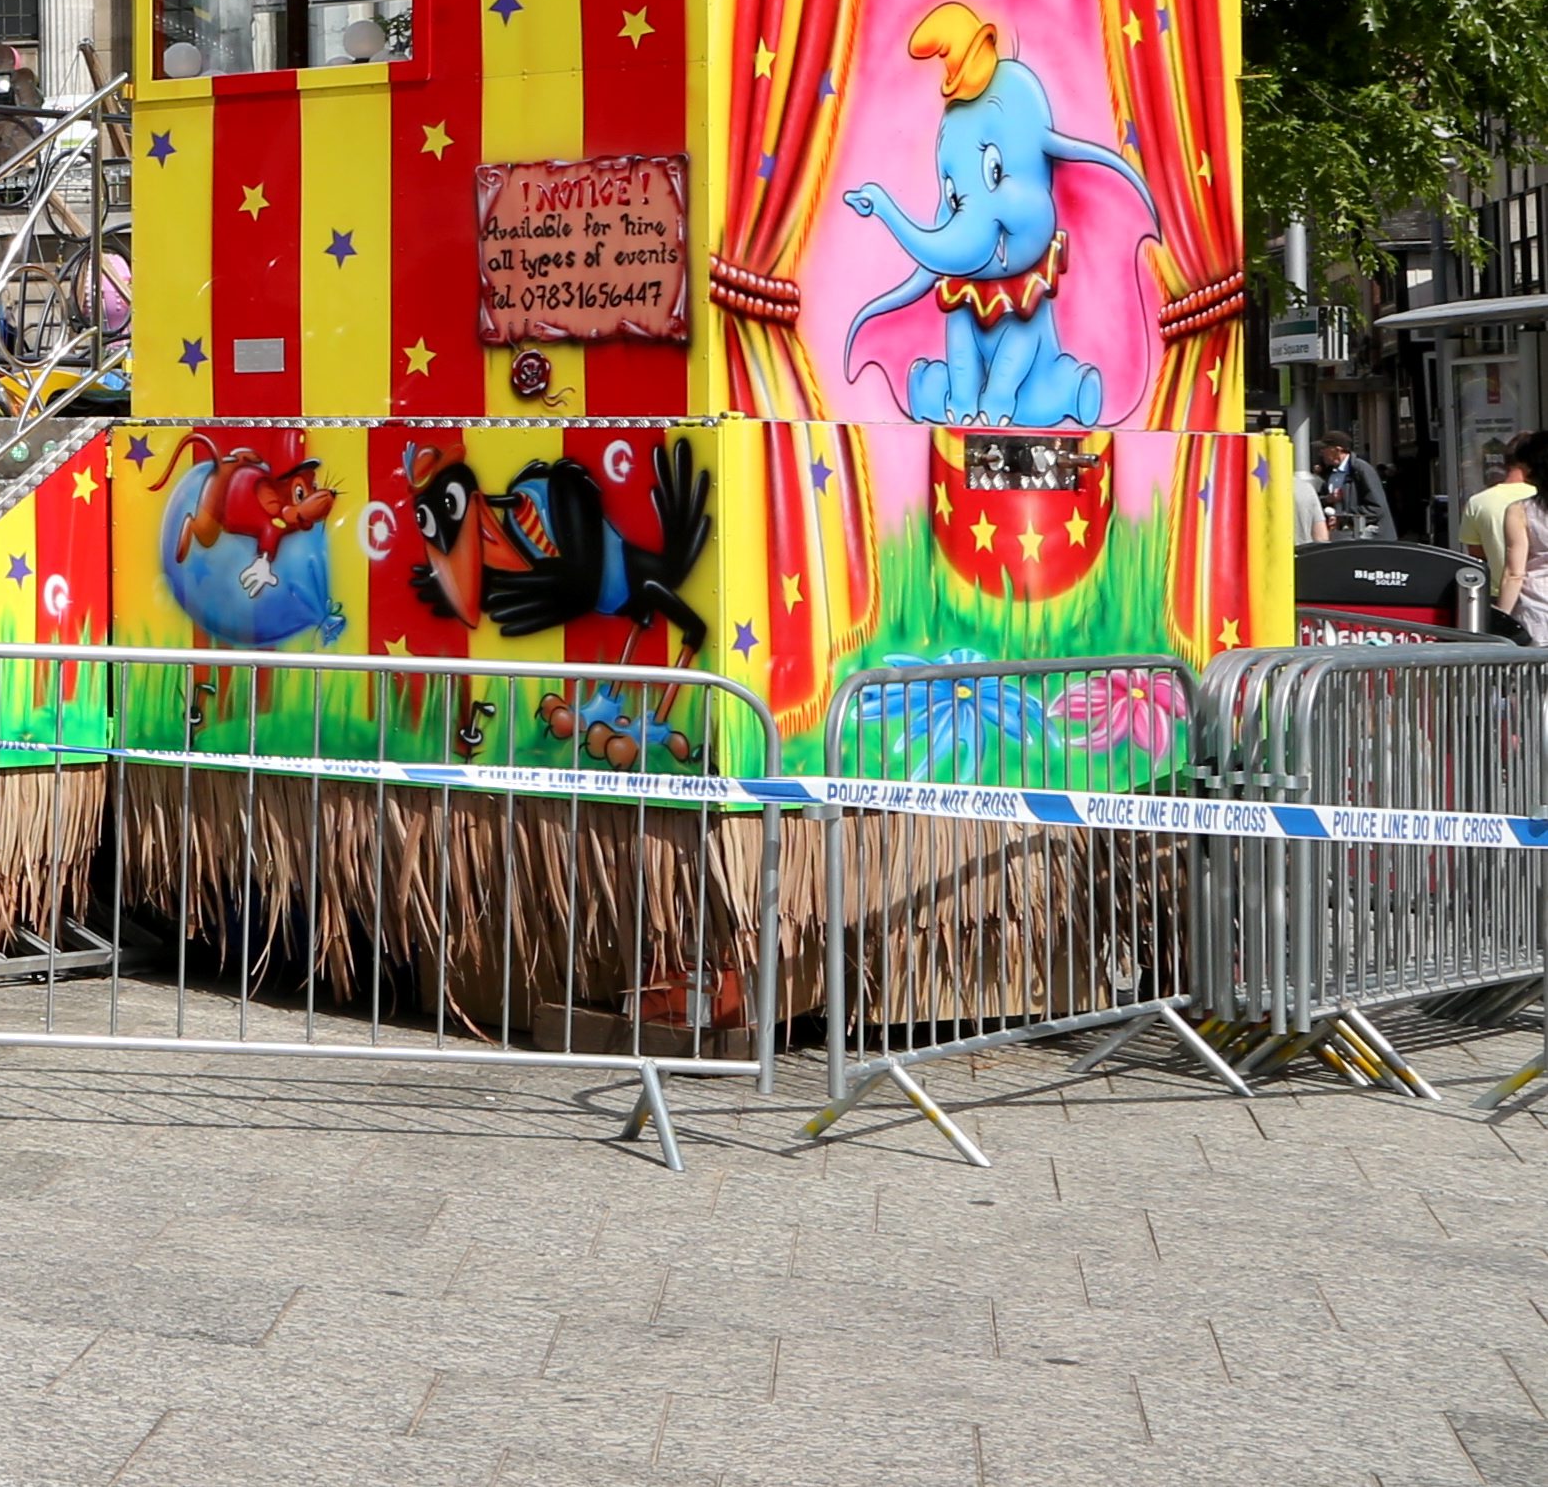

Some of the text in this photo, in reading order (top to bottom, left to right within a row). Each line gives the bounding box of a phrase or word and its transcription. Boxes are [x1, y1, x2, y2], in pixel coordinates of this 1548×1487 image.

[484, 212, 666, 241] Available for hire
[488, 242, 678, 279] all types of events
[520, 281, 663, 312] 07831656447
[1354, 570, 1409, 582] BigBelly
[1375, 578, 1401, 587] SOLAR
[549, 770, 587, 790] LINE
[594, 773, 619, 793] DO
[626, 776, 660, 795] NOT
[668, 778, 729, 798] CROSS
[827, 782, 1019, 819] POLICE LINE DO NOT CROSS
[1087, 797, 1268, 833] POLICE LINE DO NOT CROSS
[1332, 811, 1504, 844] POLICE LINE DO NOT CROSS
